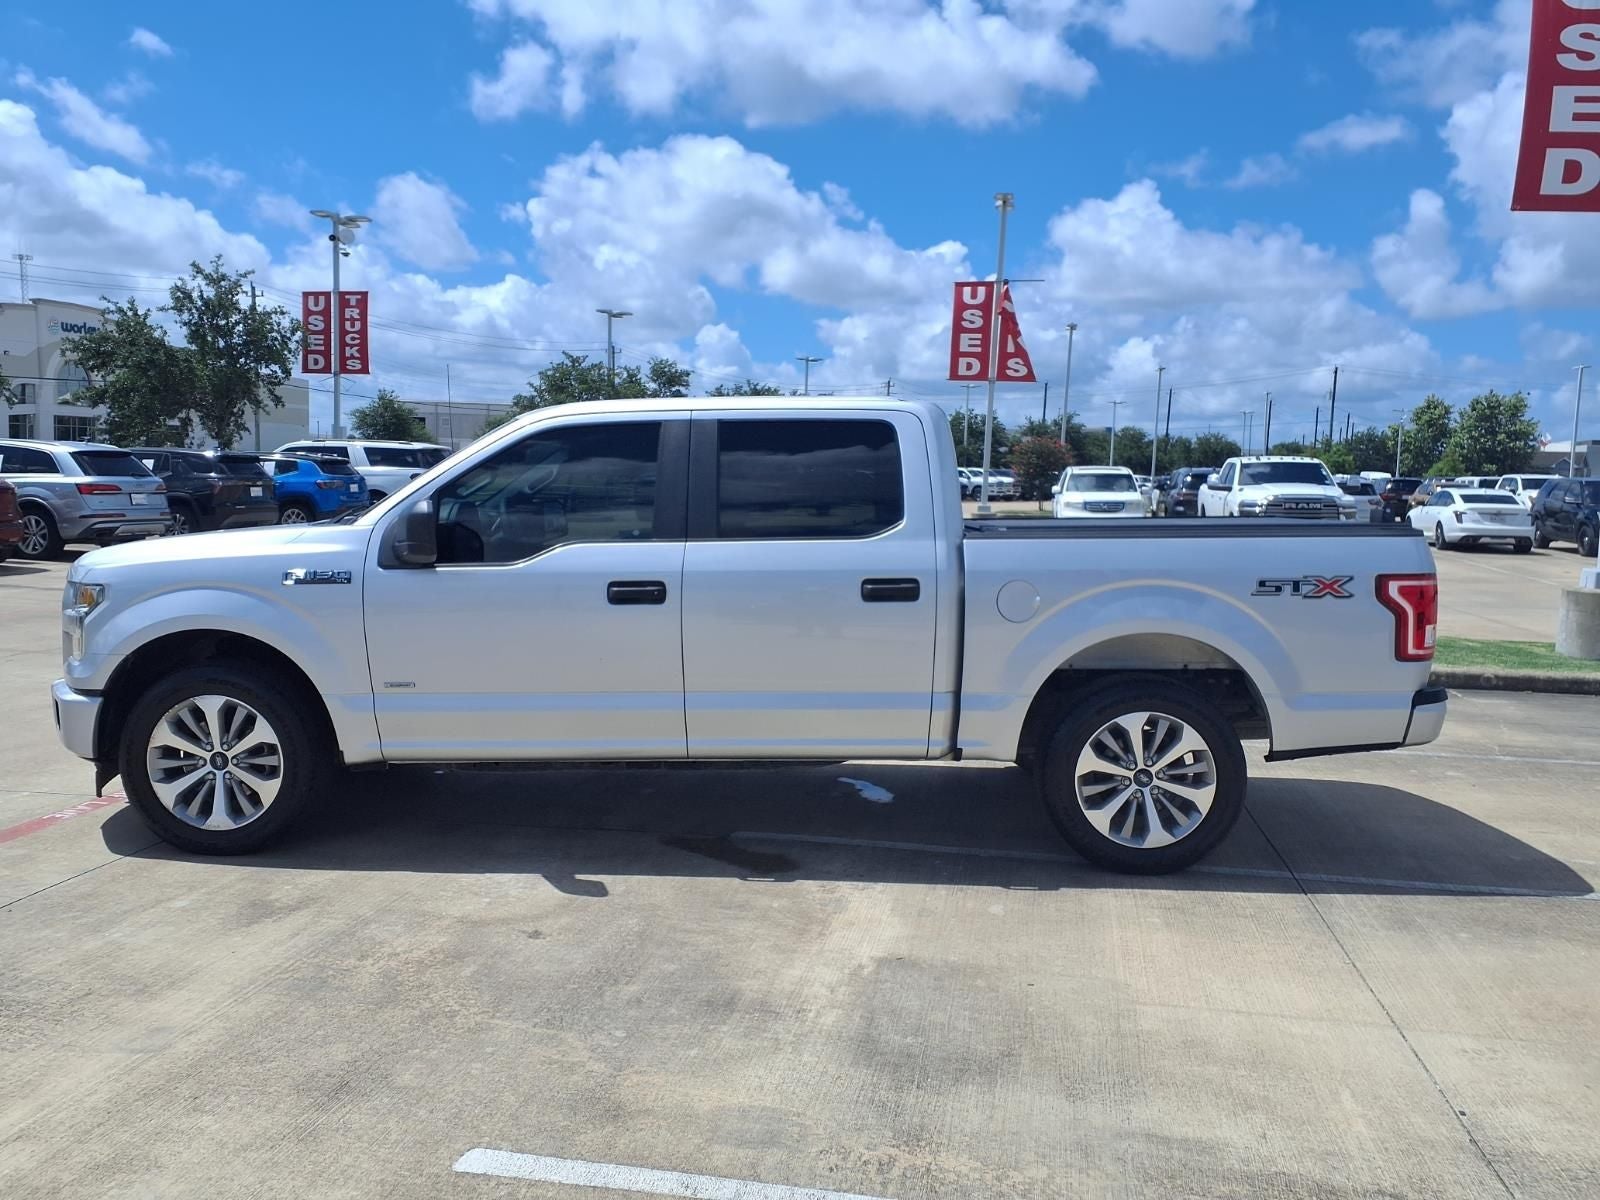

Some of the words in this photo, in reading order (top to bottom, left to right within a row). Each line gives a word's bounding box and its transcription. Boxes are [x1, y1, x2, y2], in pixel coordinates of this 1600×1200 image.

[1539, 0, 1600, 195] SED
[307, 295, 325, 370] USED
[344, 294, 362, 370] TRUCKS
[957, 286, 986, 376] USED
[1250, 575, 1355, 599] STX
